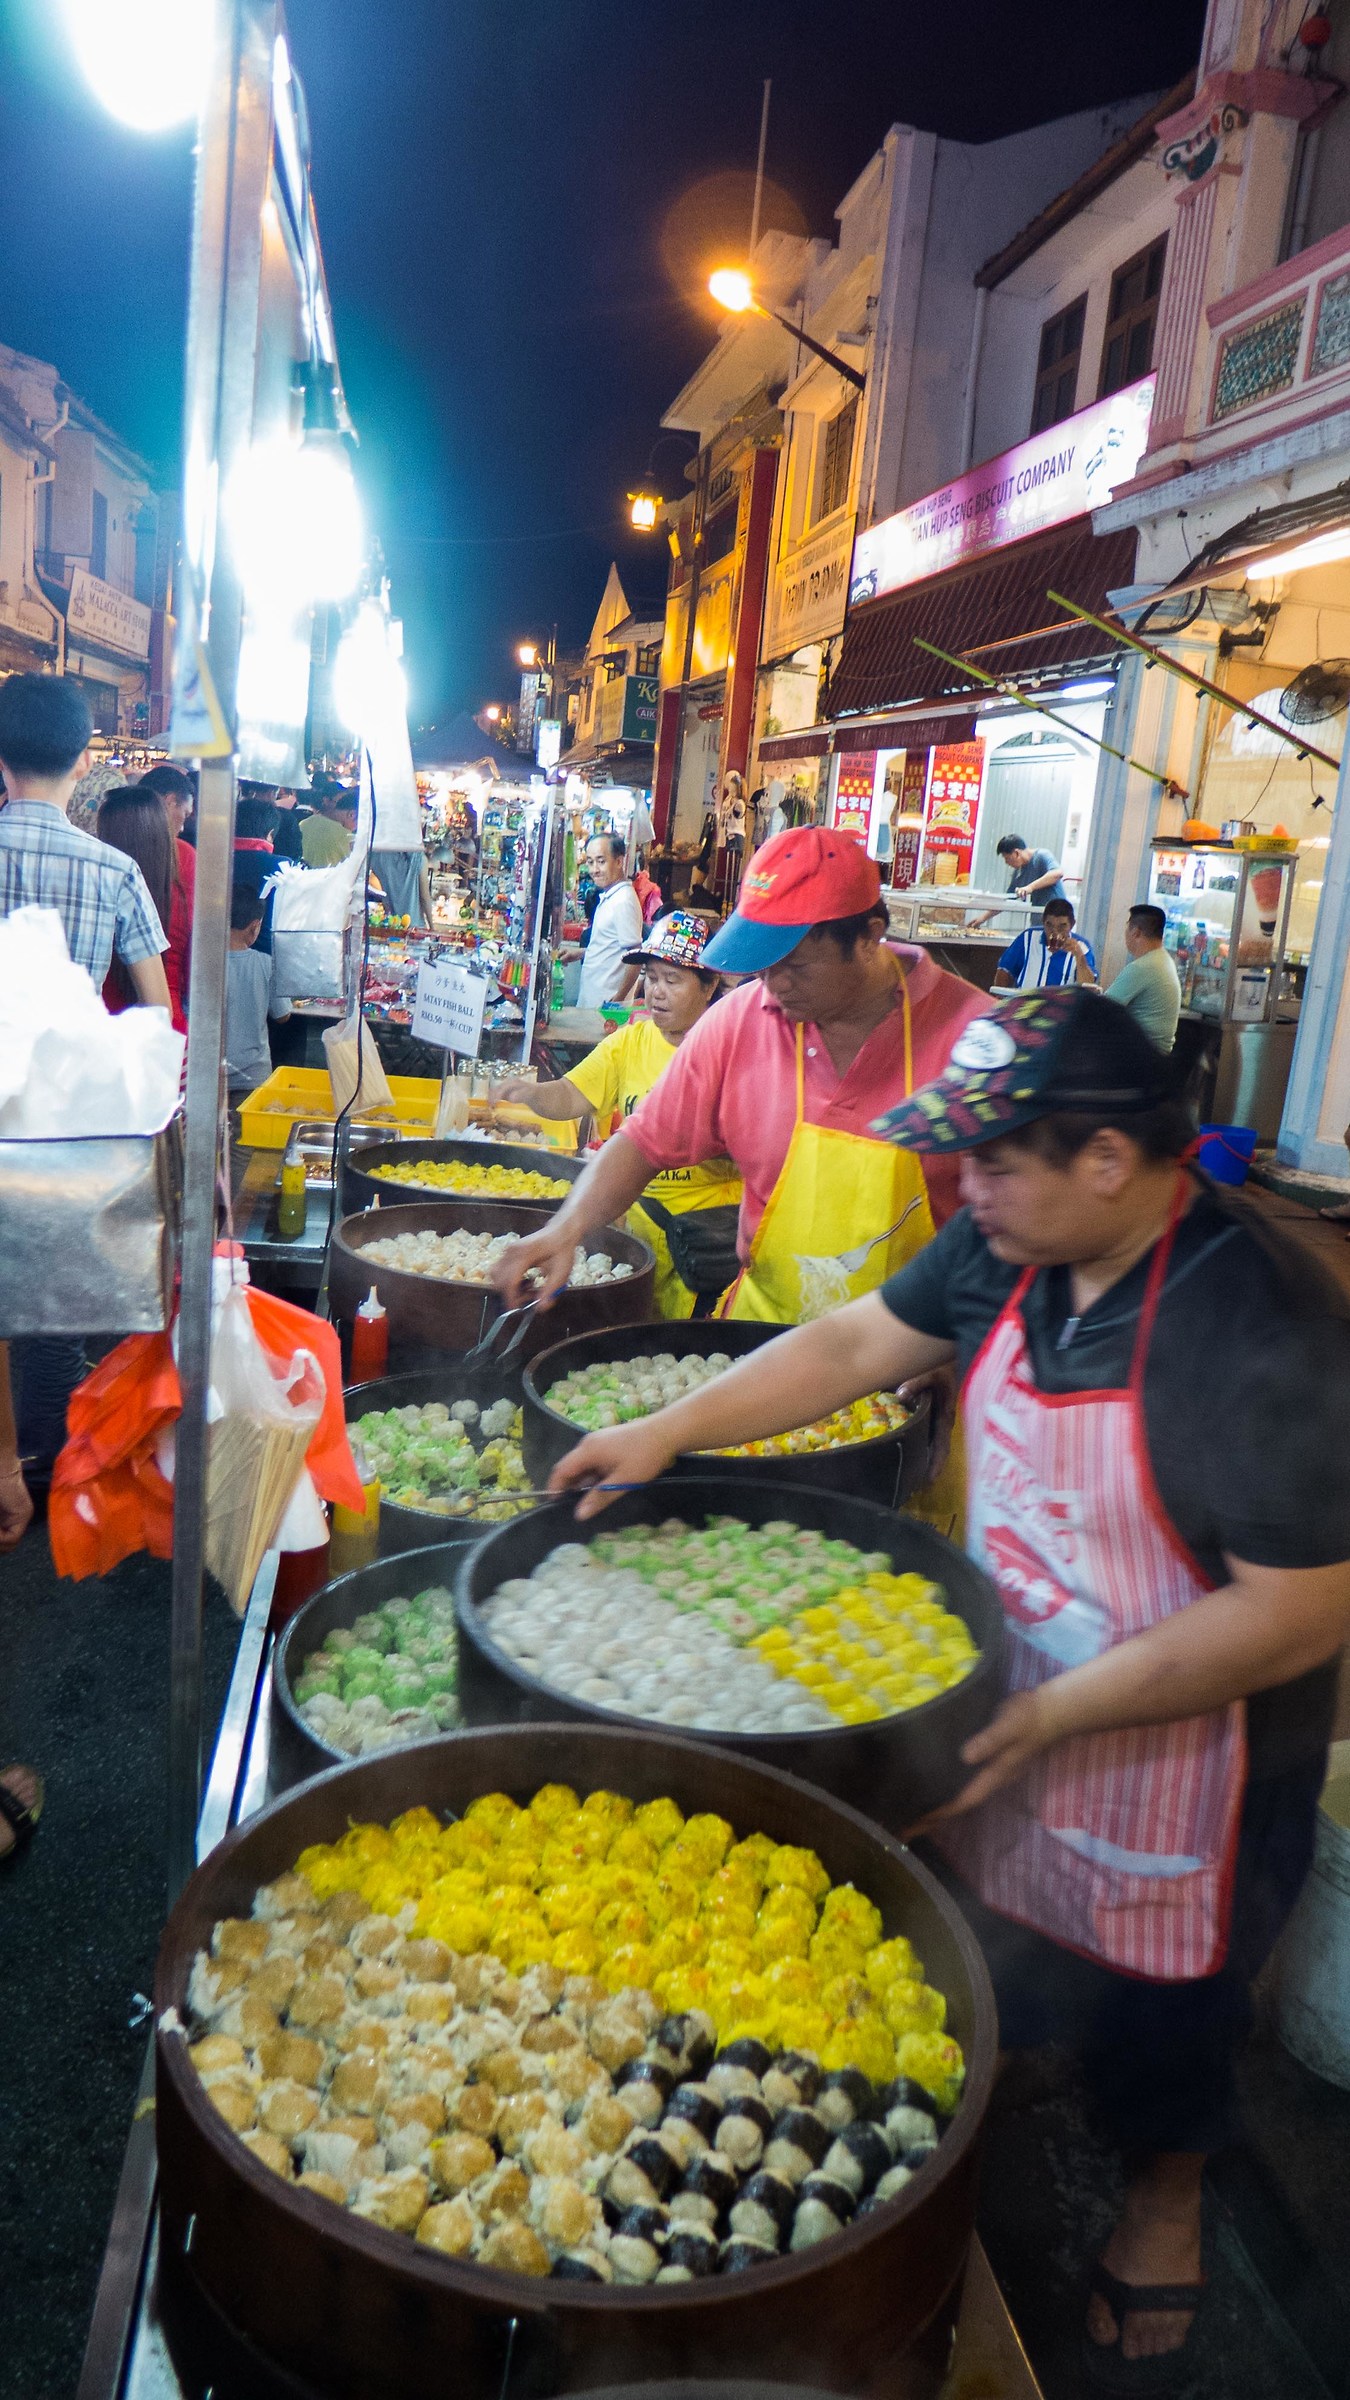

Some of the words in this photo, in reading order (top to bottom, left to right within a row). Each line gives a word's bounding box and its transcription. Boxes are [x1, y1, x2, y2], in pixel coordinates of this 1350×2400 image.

[930, 513, 948, 538] HUP
[949, 498, 973, 528] SENG
[975, 475, 1015, 516] BISCUIT
[1016, 446, 1076, 496] COMPANY
[937, 490, 952, 507] SENG
[423, 993, 442, 1007] SATAY
[442, 999, 457, 1012] FISH
[457, 1004, 475, 1017] BALL
[421, 1010, 443, 1025] RM3.50
